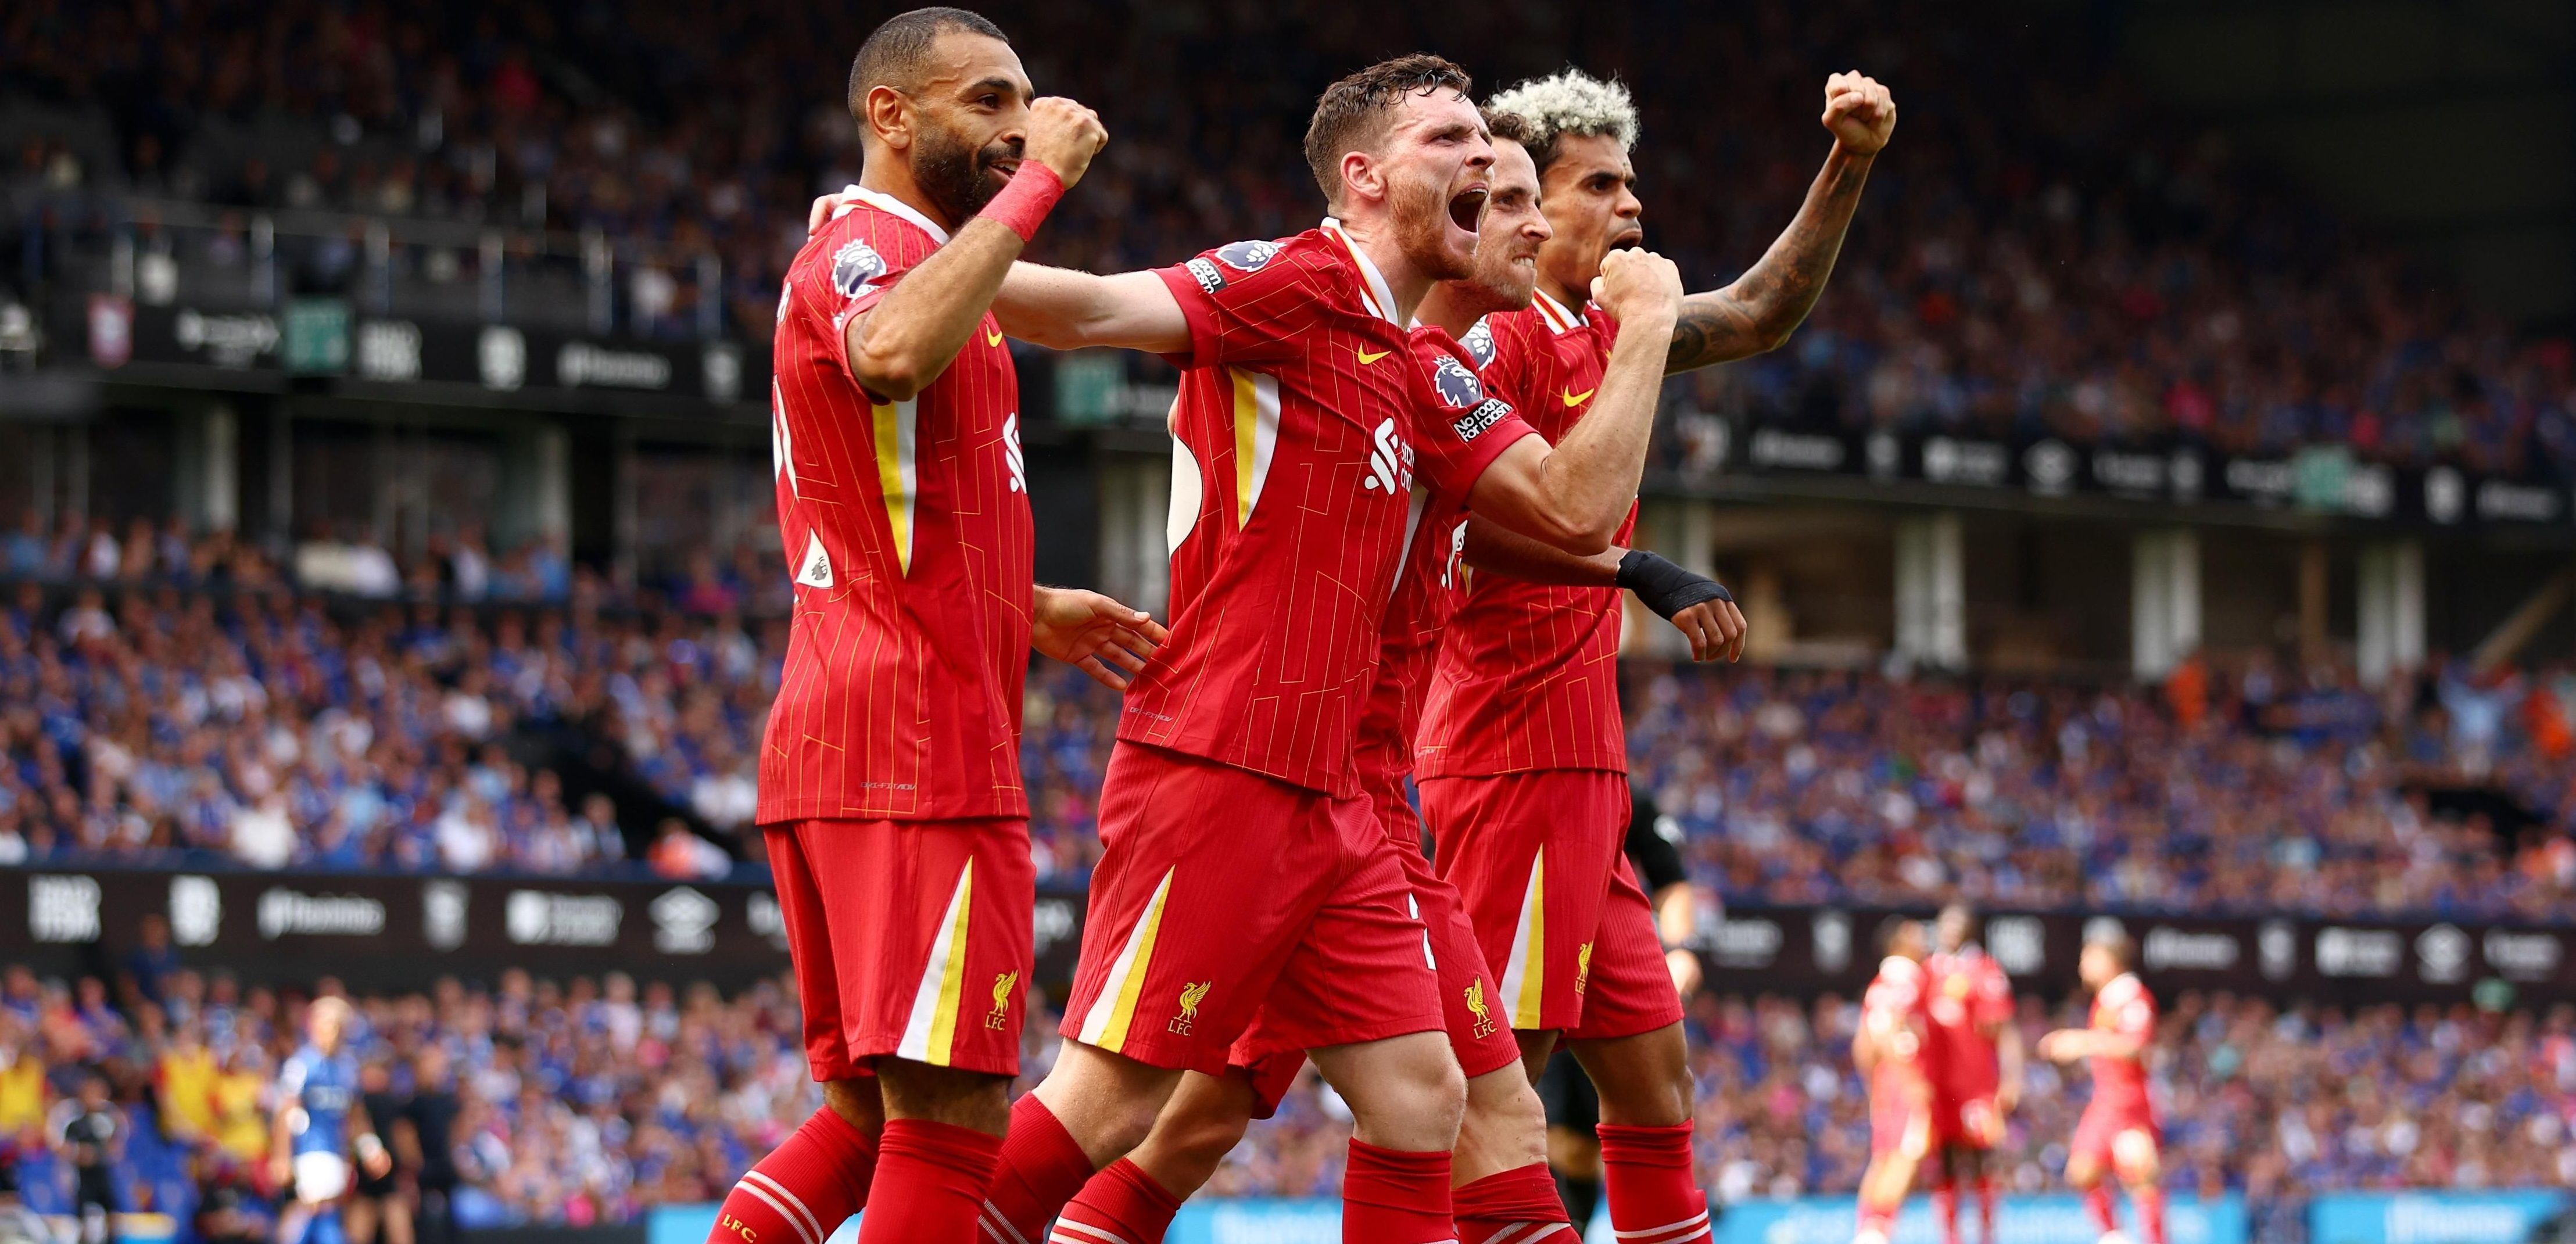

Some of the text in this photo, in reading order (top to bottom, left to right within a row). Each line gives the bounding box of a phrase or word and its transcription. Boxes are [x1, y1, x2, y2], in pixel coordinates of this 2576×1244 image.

[1454, 399, 1503, 435] No room
[1461, 424, 1480, 442] for
[722, 1213, 757, 1243] LFC
